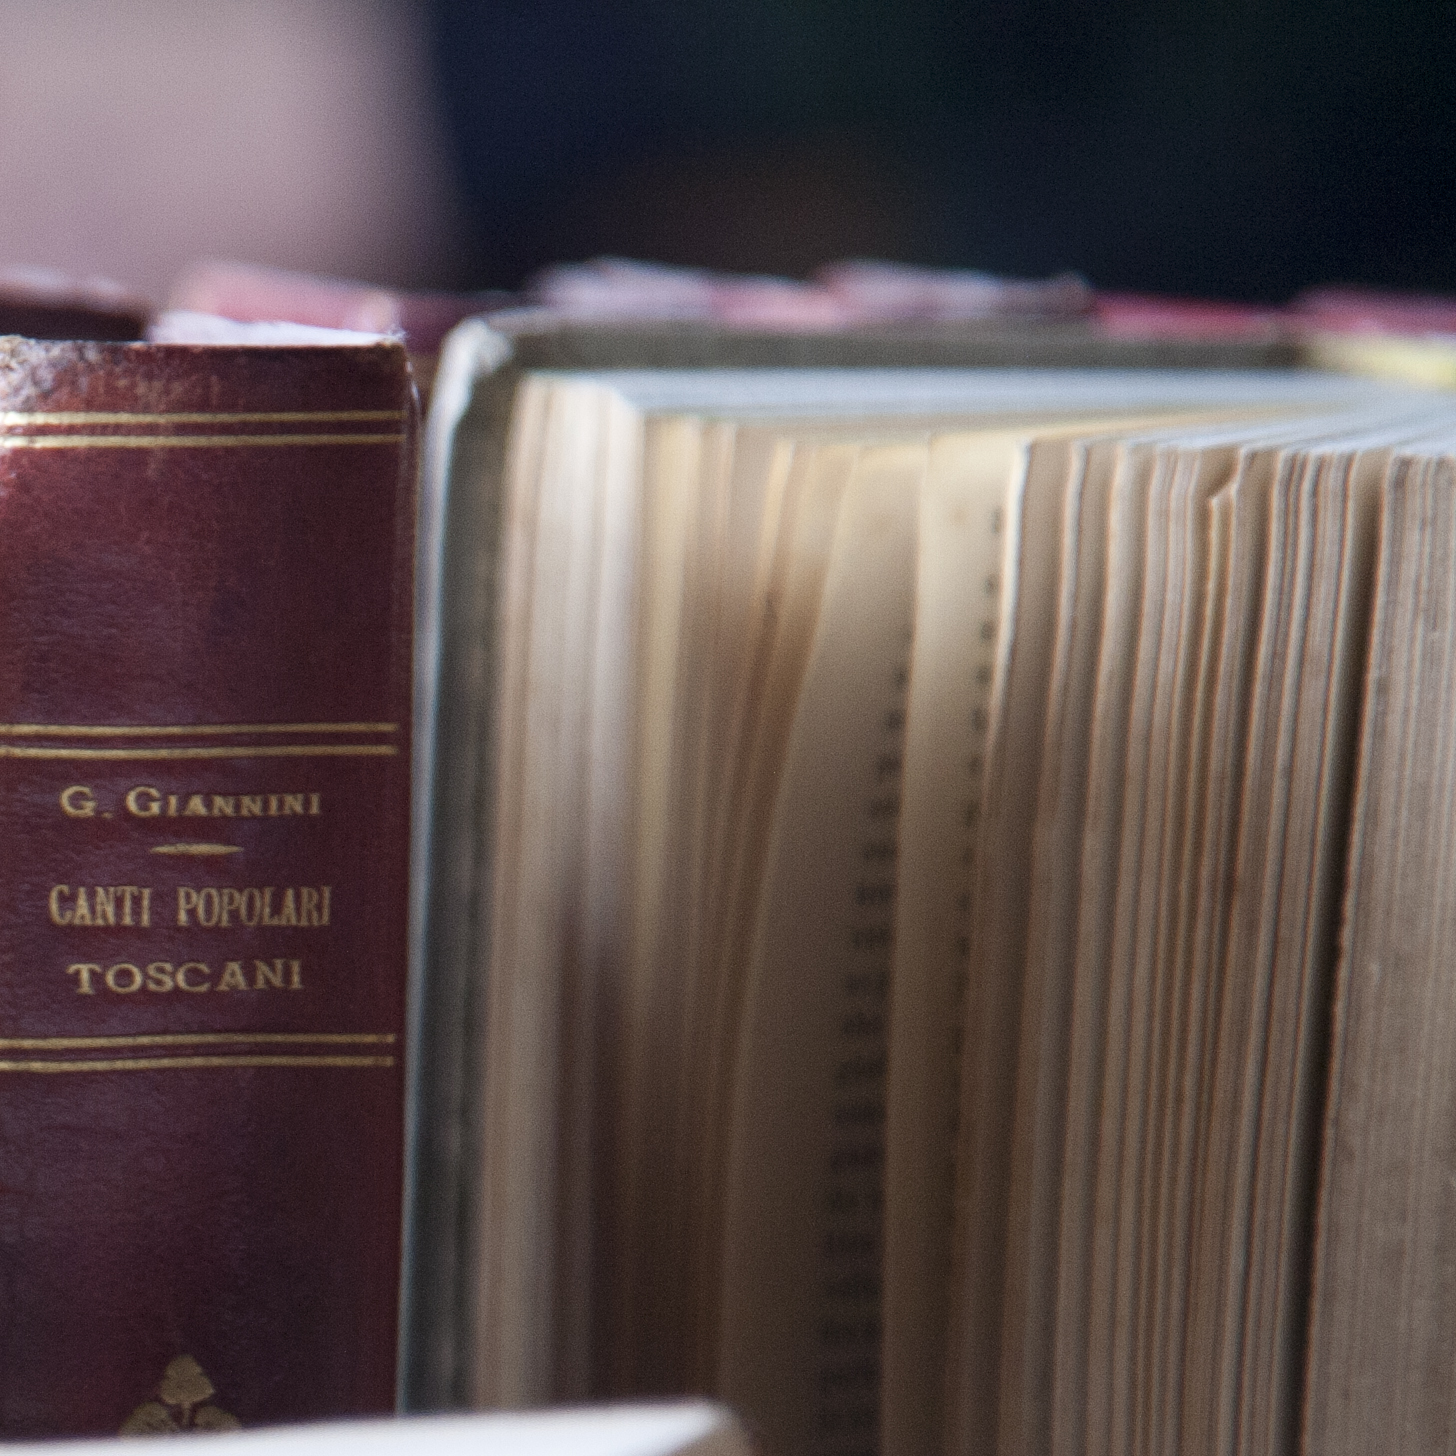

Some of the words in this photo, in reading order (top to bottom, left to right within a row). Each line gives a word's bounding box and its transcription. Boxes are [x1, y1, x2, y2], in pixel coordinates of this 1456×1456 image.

[59, 785, 114, 819] G.
[48, 884, 152, 928] CANTI
[176, 884, 333, 928] POPOLARI
[65, 958, 304, 995] TOSCANI
